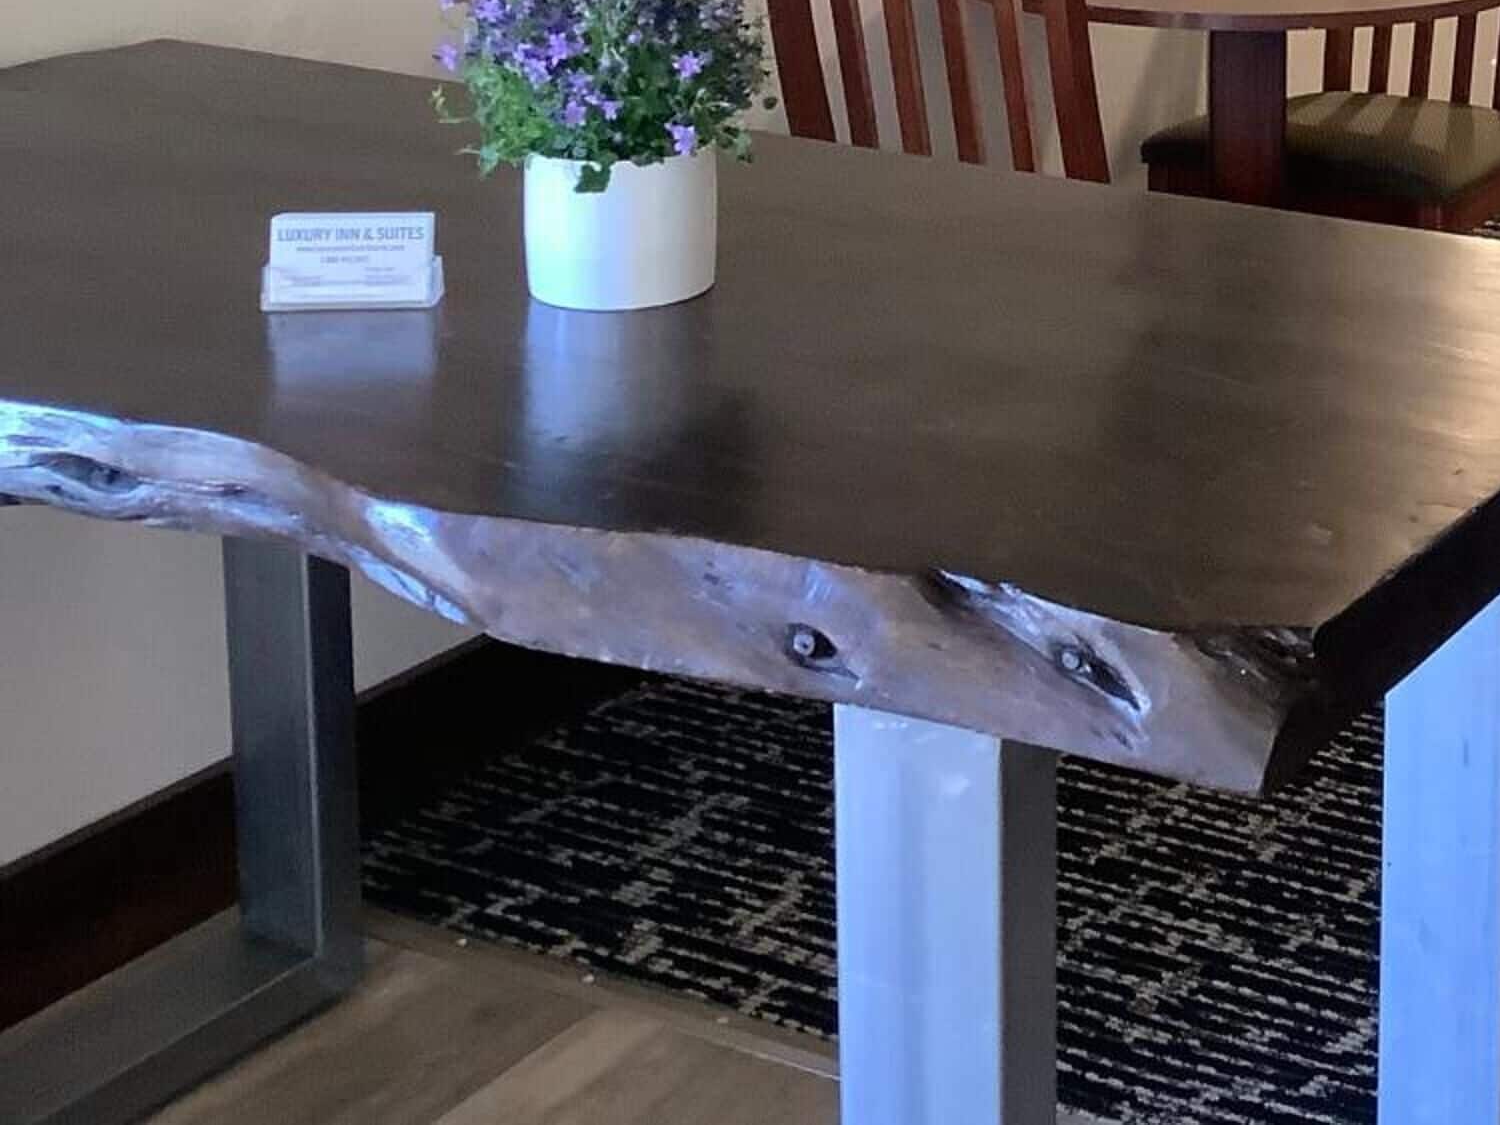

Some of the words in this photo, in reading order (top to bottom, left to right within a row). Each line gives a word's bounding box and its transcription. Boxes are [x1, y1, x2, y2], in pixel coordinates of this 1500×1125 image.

[277, 227, 331, 242] LUXURY
[336, 227, 360, 241] INN
[363, 227, 374, 240] &
[378, 226, 425, 240] SUITES
